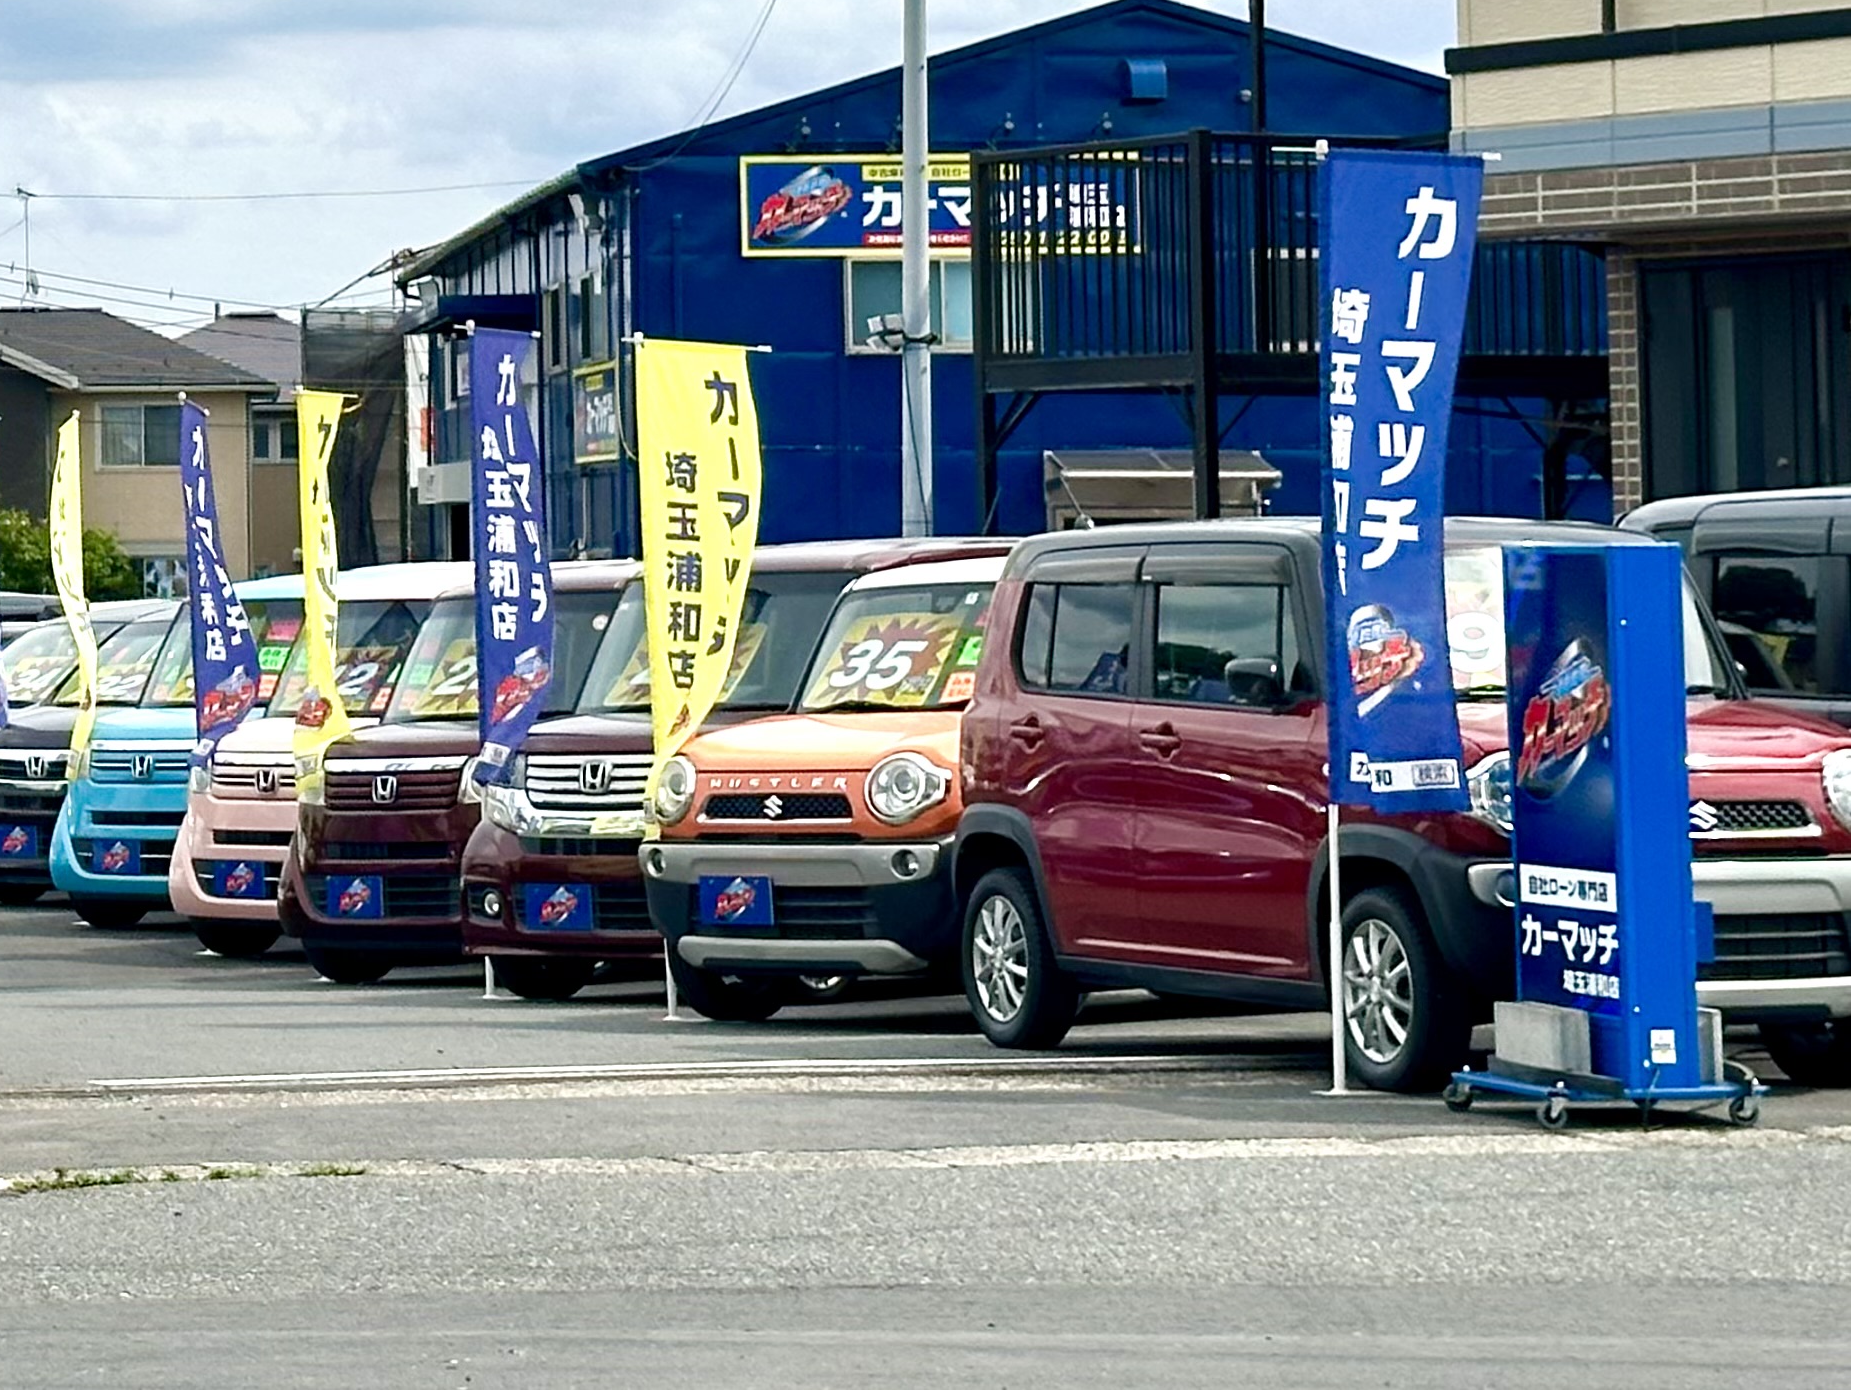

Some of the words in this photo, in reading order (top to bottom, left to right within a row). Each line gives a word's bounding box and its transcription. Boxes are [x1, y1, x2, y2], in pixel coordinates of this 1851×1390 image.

[1358, 185, 1458, 571] カーマッチ
[665, 451, 702, 690] 埼玉浦和店
[829, 638, 929, 690] 35
[709, 776, 848, 791] HUSTLER
[1521, 913, 1619, 965] カーマッチ
